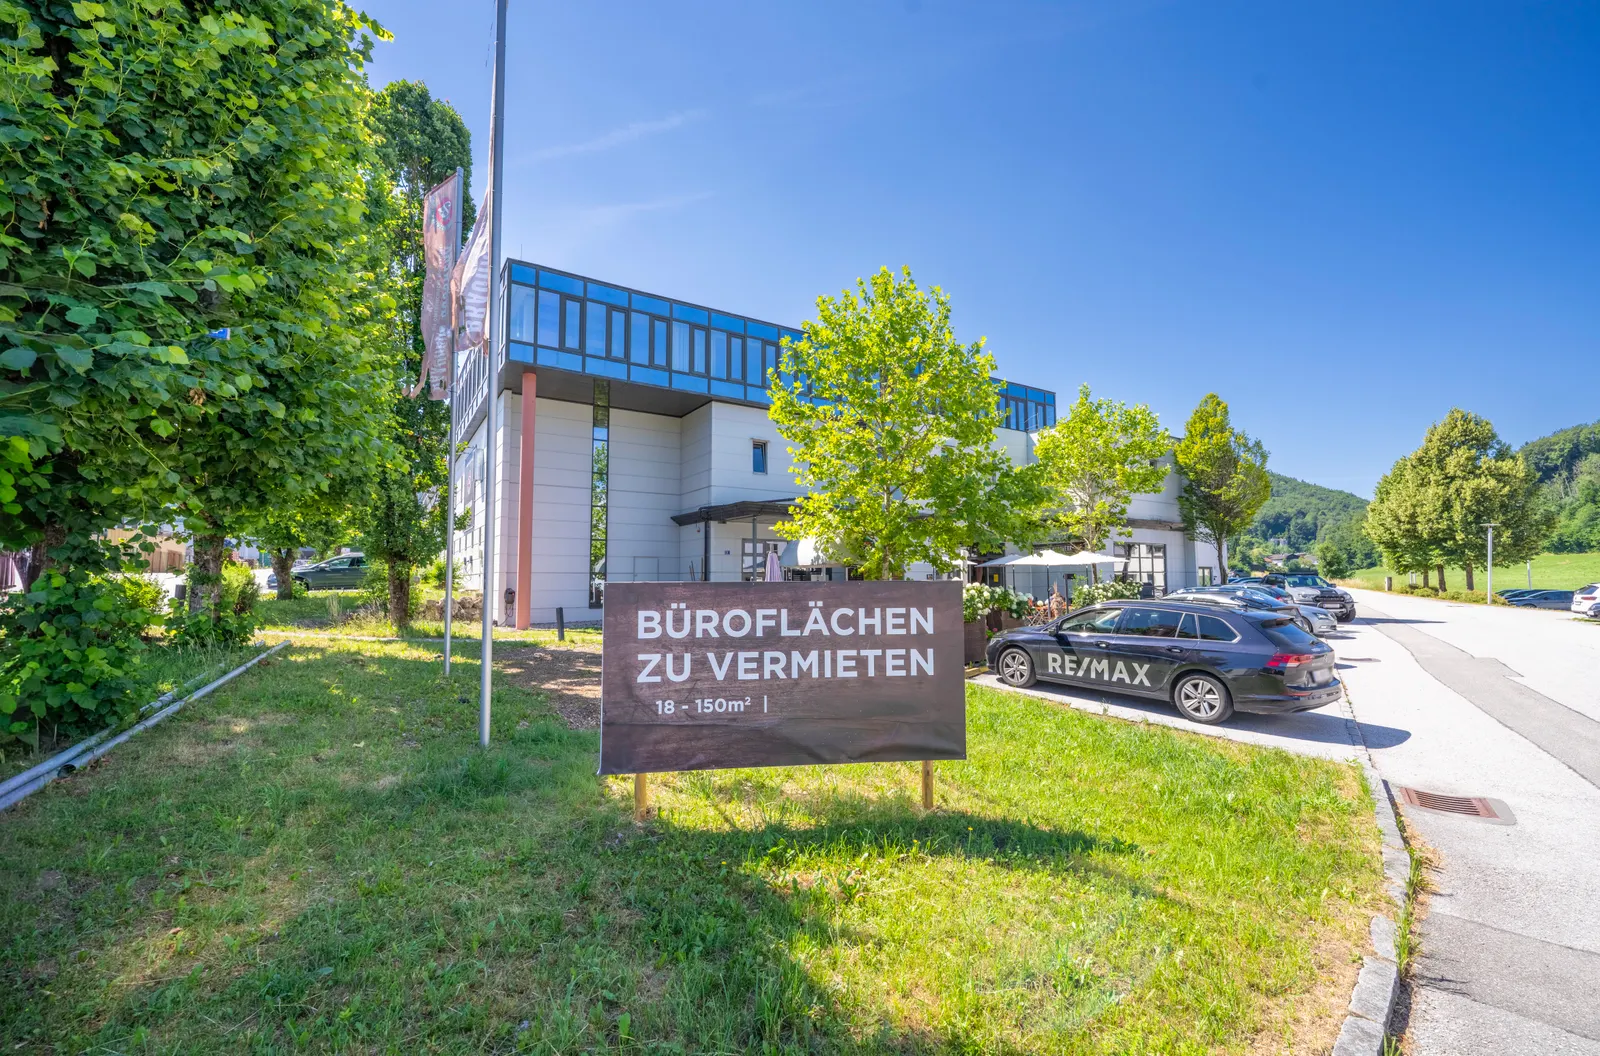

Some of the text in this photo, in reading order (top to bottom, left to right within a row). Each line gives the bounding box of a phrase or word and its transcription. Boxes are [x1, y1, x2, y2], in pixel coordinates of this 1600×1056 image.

[637, 601, 934, 640] BÜROFLÄCHEN
[636, 648, 935, 684] ZU VERMIETEN
[1047, 652, 1152, 687] RE/MAX
[655, 699, 676, 715] 18
